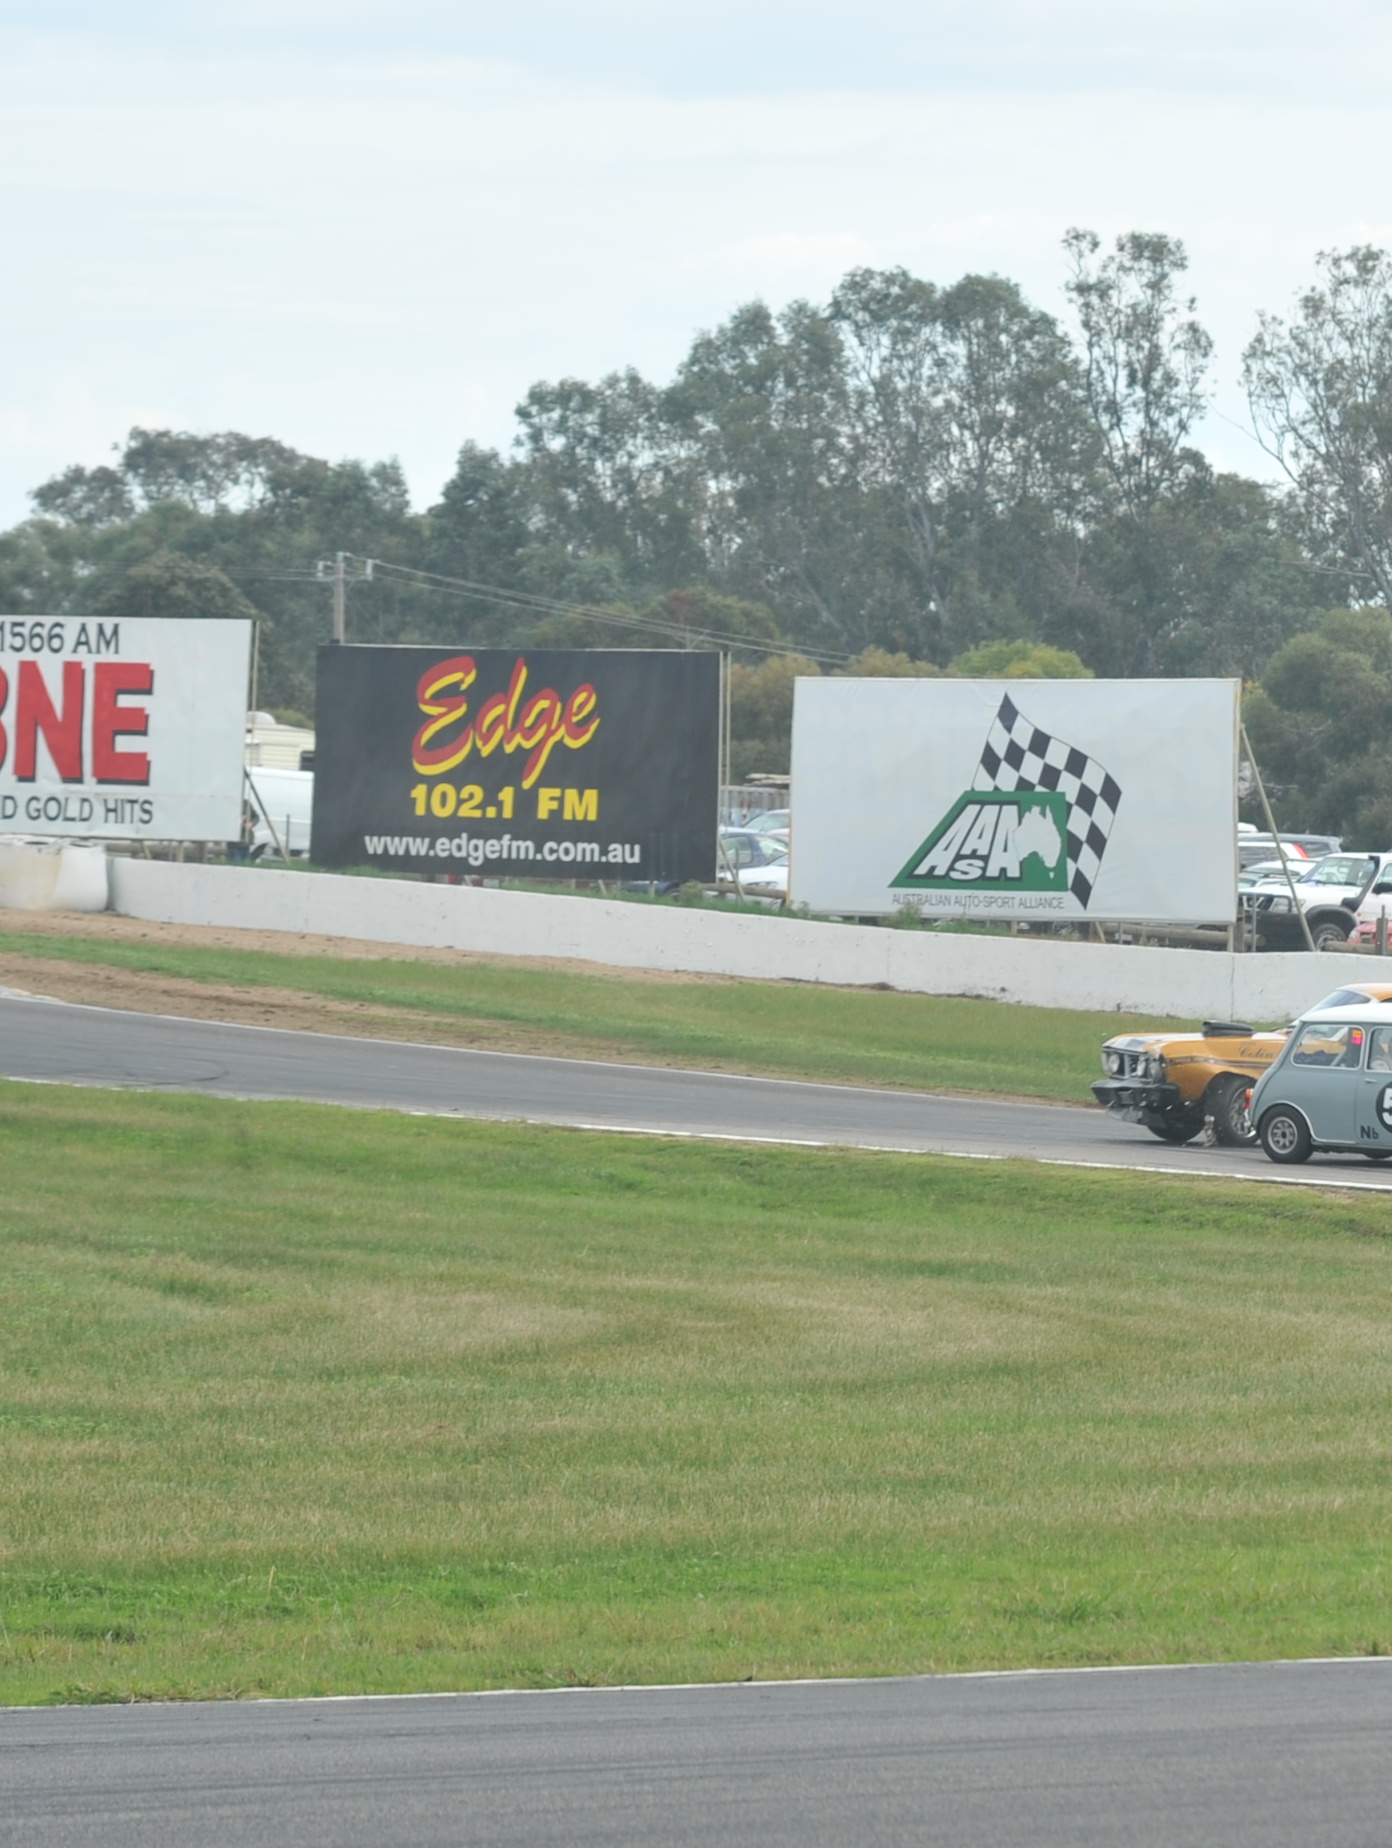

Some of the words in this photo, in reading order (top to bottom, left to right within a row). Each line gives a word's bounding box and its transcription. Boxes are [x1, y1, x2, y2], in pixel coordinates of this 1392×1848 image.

[71, 623, 120, 654] AM
[0, 660, 154, 786] NE
[412, 655, 600, 789] Edge
[25, 796, 94, 822] GOLD
[103, 798, 154, 824] HITS
[410, 783, 515, 819] 102.1
[536, 788, 598, 821] FM
[364, 832, 641, 867] www.edgefm.com.au
[891, 893, 951, 907] AUSTRALIAN
[953, 894, 1016, 909] AUTO-SPORT
[1017, 896, 1065, 910] ALLIANCE
